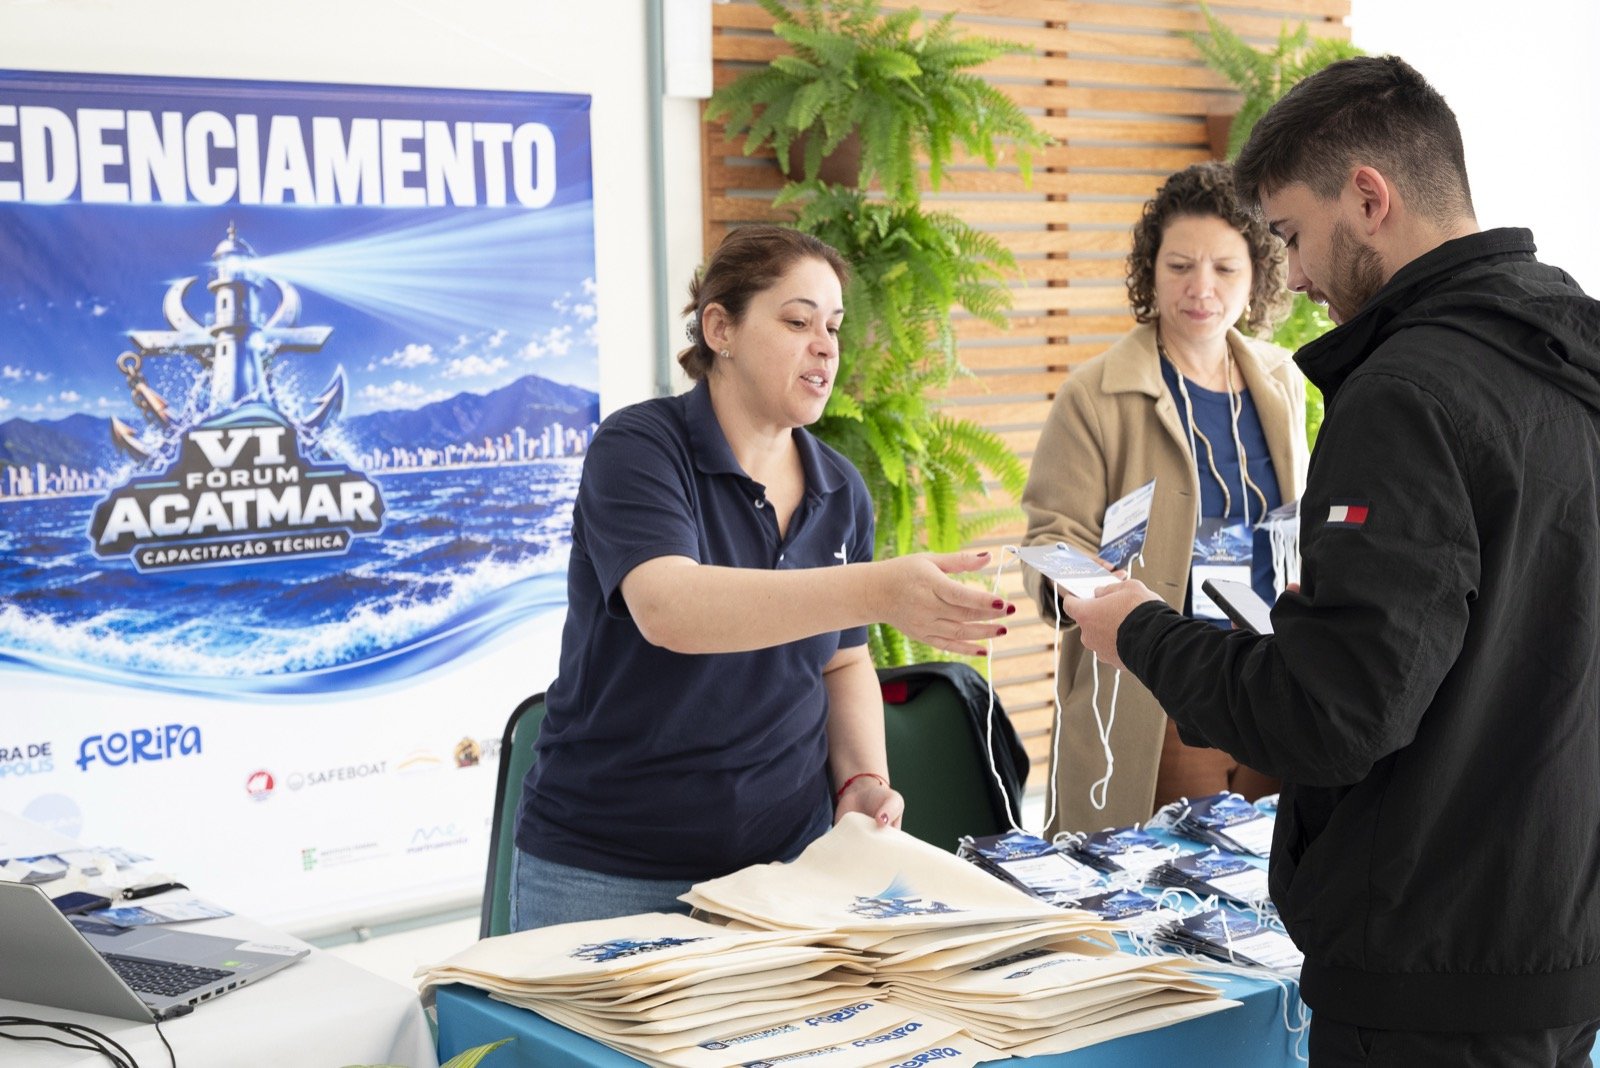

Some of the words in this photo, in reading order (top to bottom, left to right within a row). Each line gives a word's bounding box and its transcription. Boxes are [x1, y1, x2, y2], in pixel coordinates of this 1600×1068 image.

[188, 426, 287, 468] VI
[186, 466, 299, 490] FÓRUM
[99, 480, 379, 546] ACATMAR
[142, 540, 267, 566] CAPACITAÇÃO
[272, 534, 344, 553] TÉCNICA
[28, 742, 52, 758] DE
[307, 761, 388, 786] SAFEBOAT
